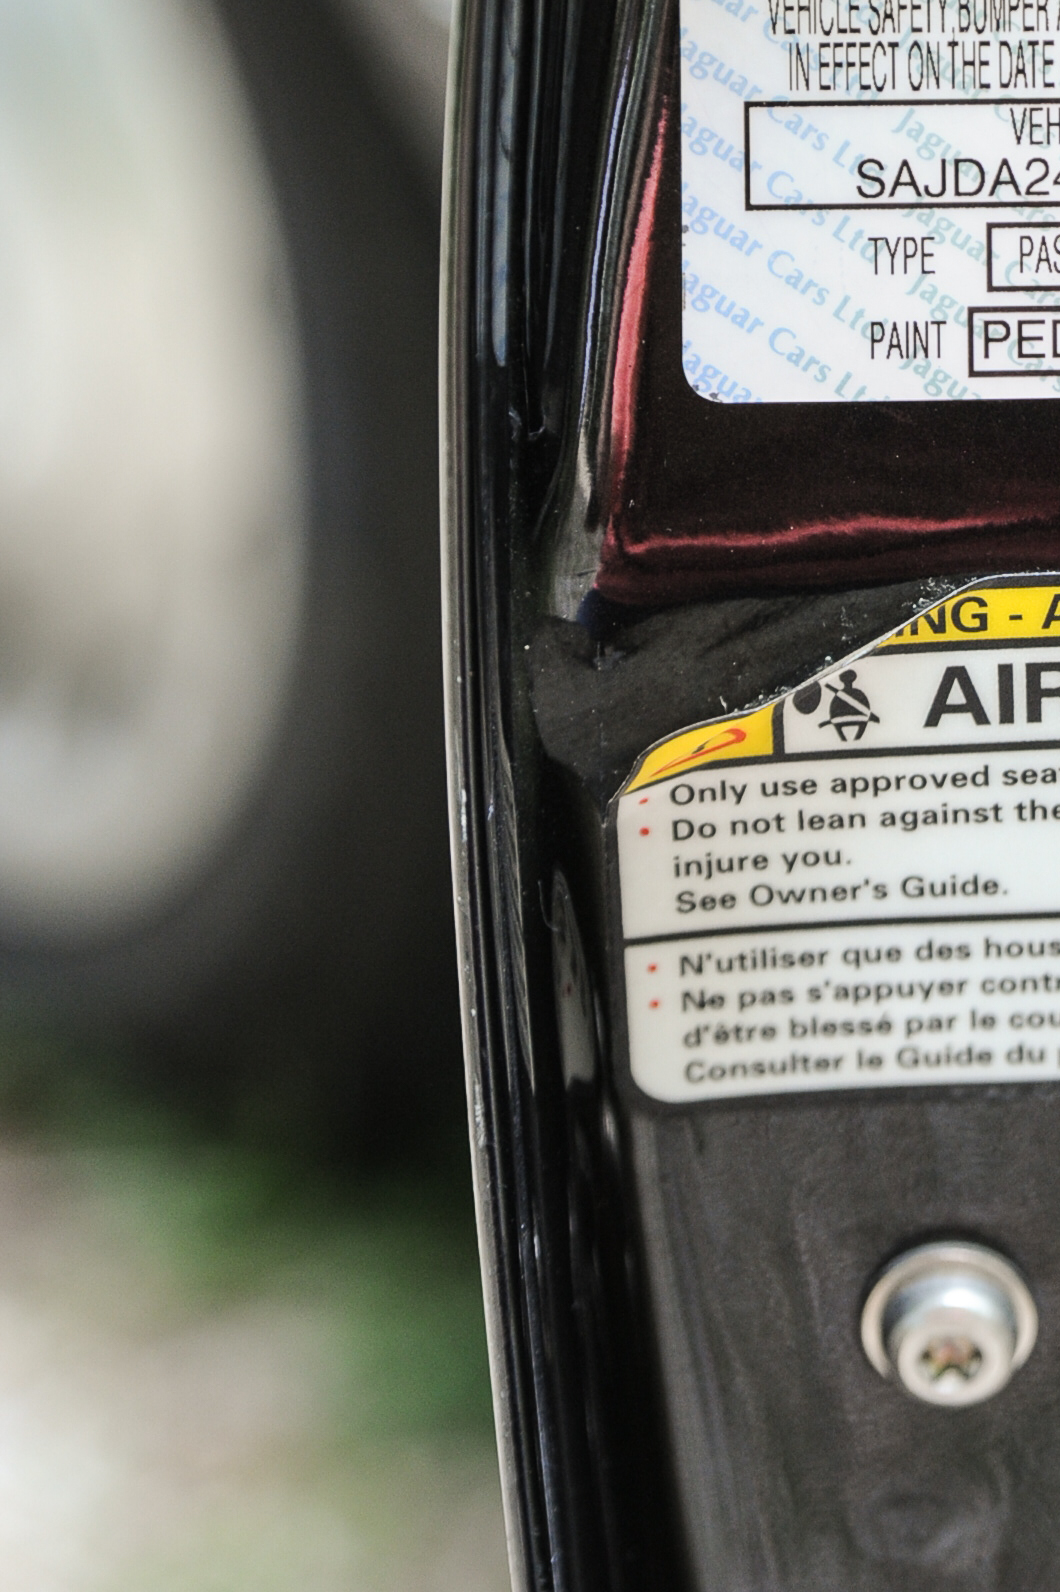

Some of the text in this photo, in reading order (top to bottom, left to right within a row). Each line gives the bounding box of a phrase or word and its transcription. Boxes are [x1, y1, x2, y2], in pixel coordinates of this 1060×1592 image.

[788, 42, 810, 91] IN
[818, 40, 900, 93] EFFECT
[908, 40, 940, 92] ON
[947, 38, 991, 90] THE
[999, 40, 1055, 89] DATE
[867, 236, 936, 276] TYPE
[870, 320, 947, 360] PAINT
[669, 780, 747, 806] Only
[760, 779, 818, 798] use
[830, 764, 990, 799] approved
[672, 819, 717, 842] Do
[730, 813, 785, 836] not
[798, 809, 866, 831] lean
[880, 803, 1002, 832] against
[674, 849, 852, 880] injure you.
[676, 875, 1009, 914] See Owner's Guide.
[679, 948, 828, 977] N'utiliser
[842, 942, 901, 969] que
[915, 939, 971, 961] des
[682, 990, 725, 1011] Ne
[738, 989, 795, 1012] pas
[807, 980, 967, 1005] s'appuyer
[905, 1012, 957, 1038] par
[970, 1009, 997, 1030] le
[684, 1053, 843, 1084] Consulter
[857, 1051, 884, 1070] le
[896, 1045, 993, 1068] Guide
[1006, 1044, 1045, 1064] du
